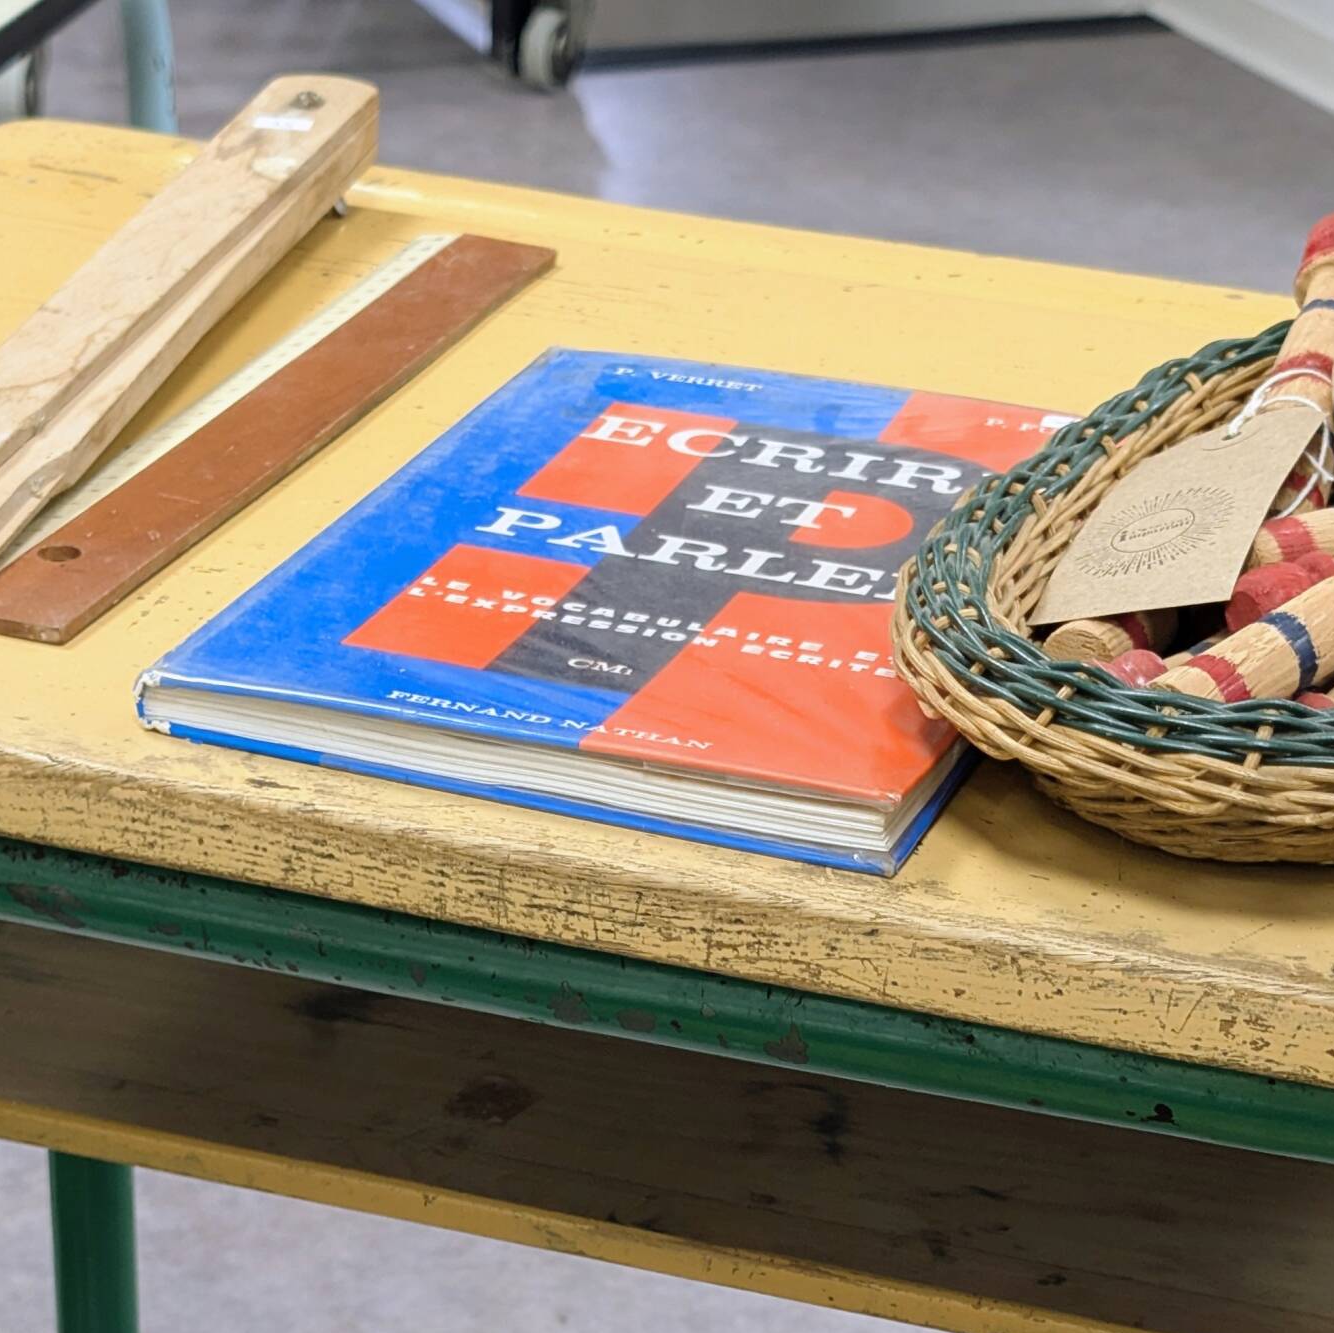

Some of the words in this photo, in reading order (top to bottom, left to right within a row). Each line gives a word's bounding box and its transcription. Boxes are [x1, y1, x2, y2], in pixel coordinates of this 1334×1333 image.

[614, 366, 636, 378] P.
[650, 371, 764, 392] VERRET
[579, 415, 995, 495] ECRIR
[686, 484, 857, 530] ET
[407, 587, 718, 648] L'EXPRESSION
[740, 644, 897, 678] ECRITE
[421, 576, 471, 591] LE
[502, 590, 824, 652] VOCABULAIRE
[855, 651, 896, 665] E
[386, 690, 552, 724] FERNAND
[560, 720, 714, 750] NATHAN
